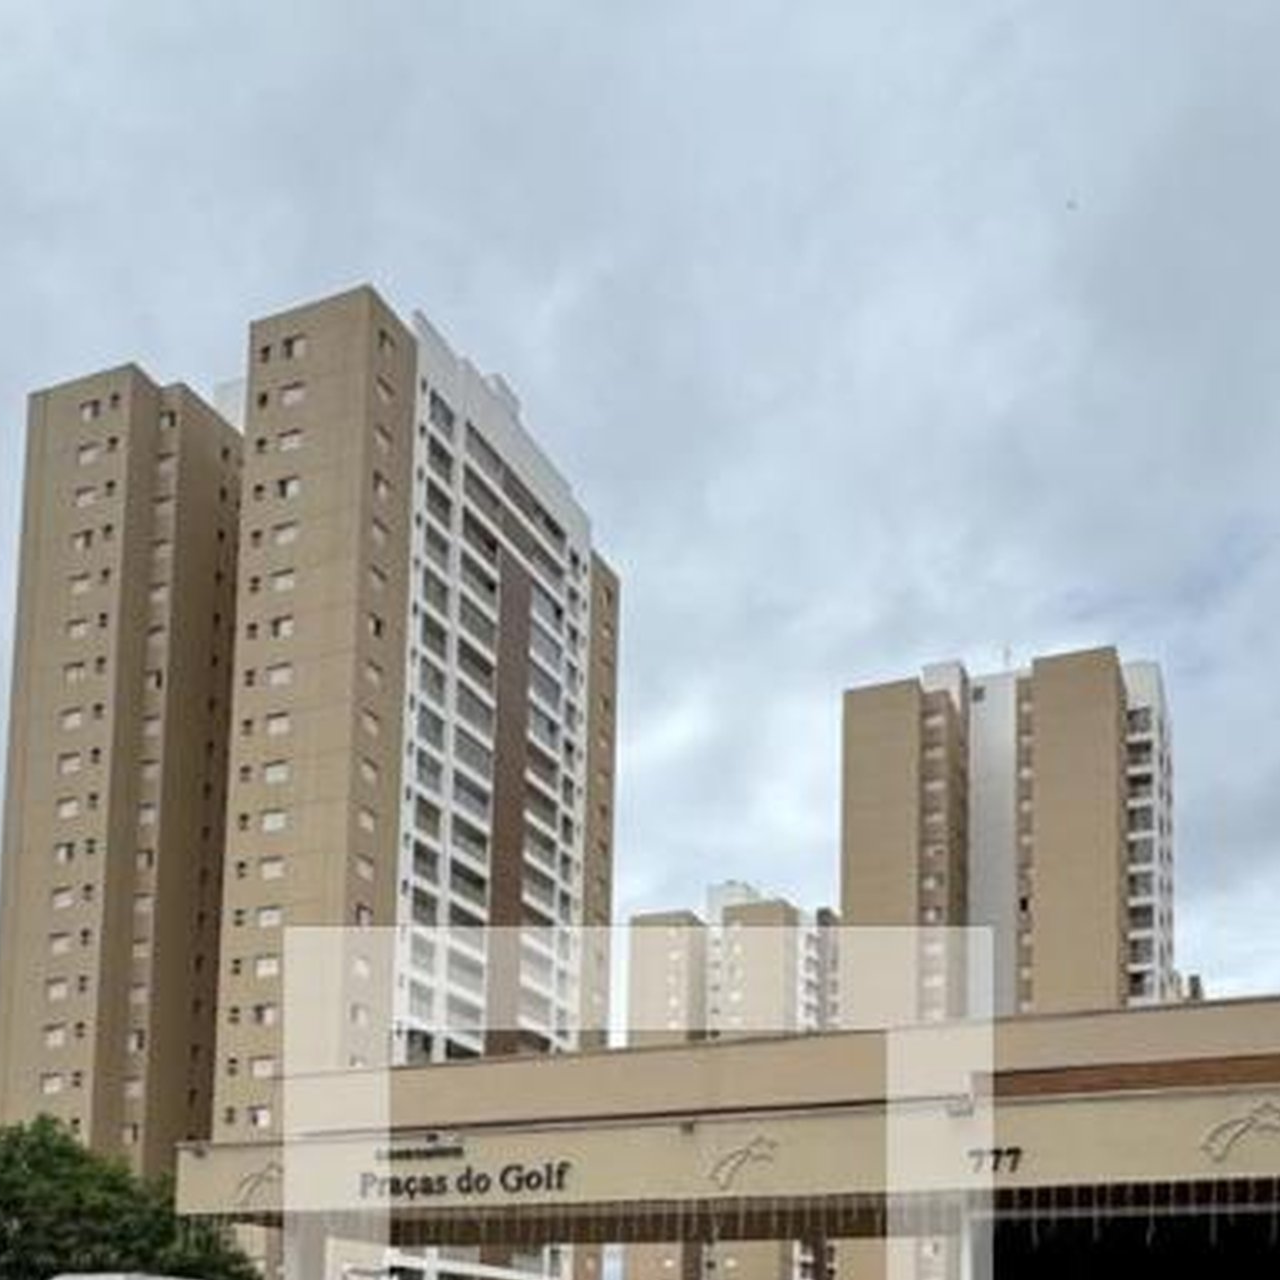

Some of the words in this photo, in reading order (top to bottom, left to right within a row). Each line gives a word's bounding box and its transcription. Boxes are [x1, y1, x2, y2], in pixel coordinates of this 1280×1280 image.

[968, 1147, 1022, 1172] 777
[360, 1172, 448, 1199] Praças
[457, 1165, 491, 1194] do
[500, 1162, 571, 1193] Golf
